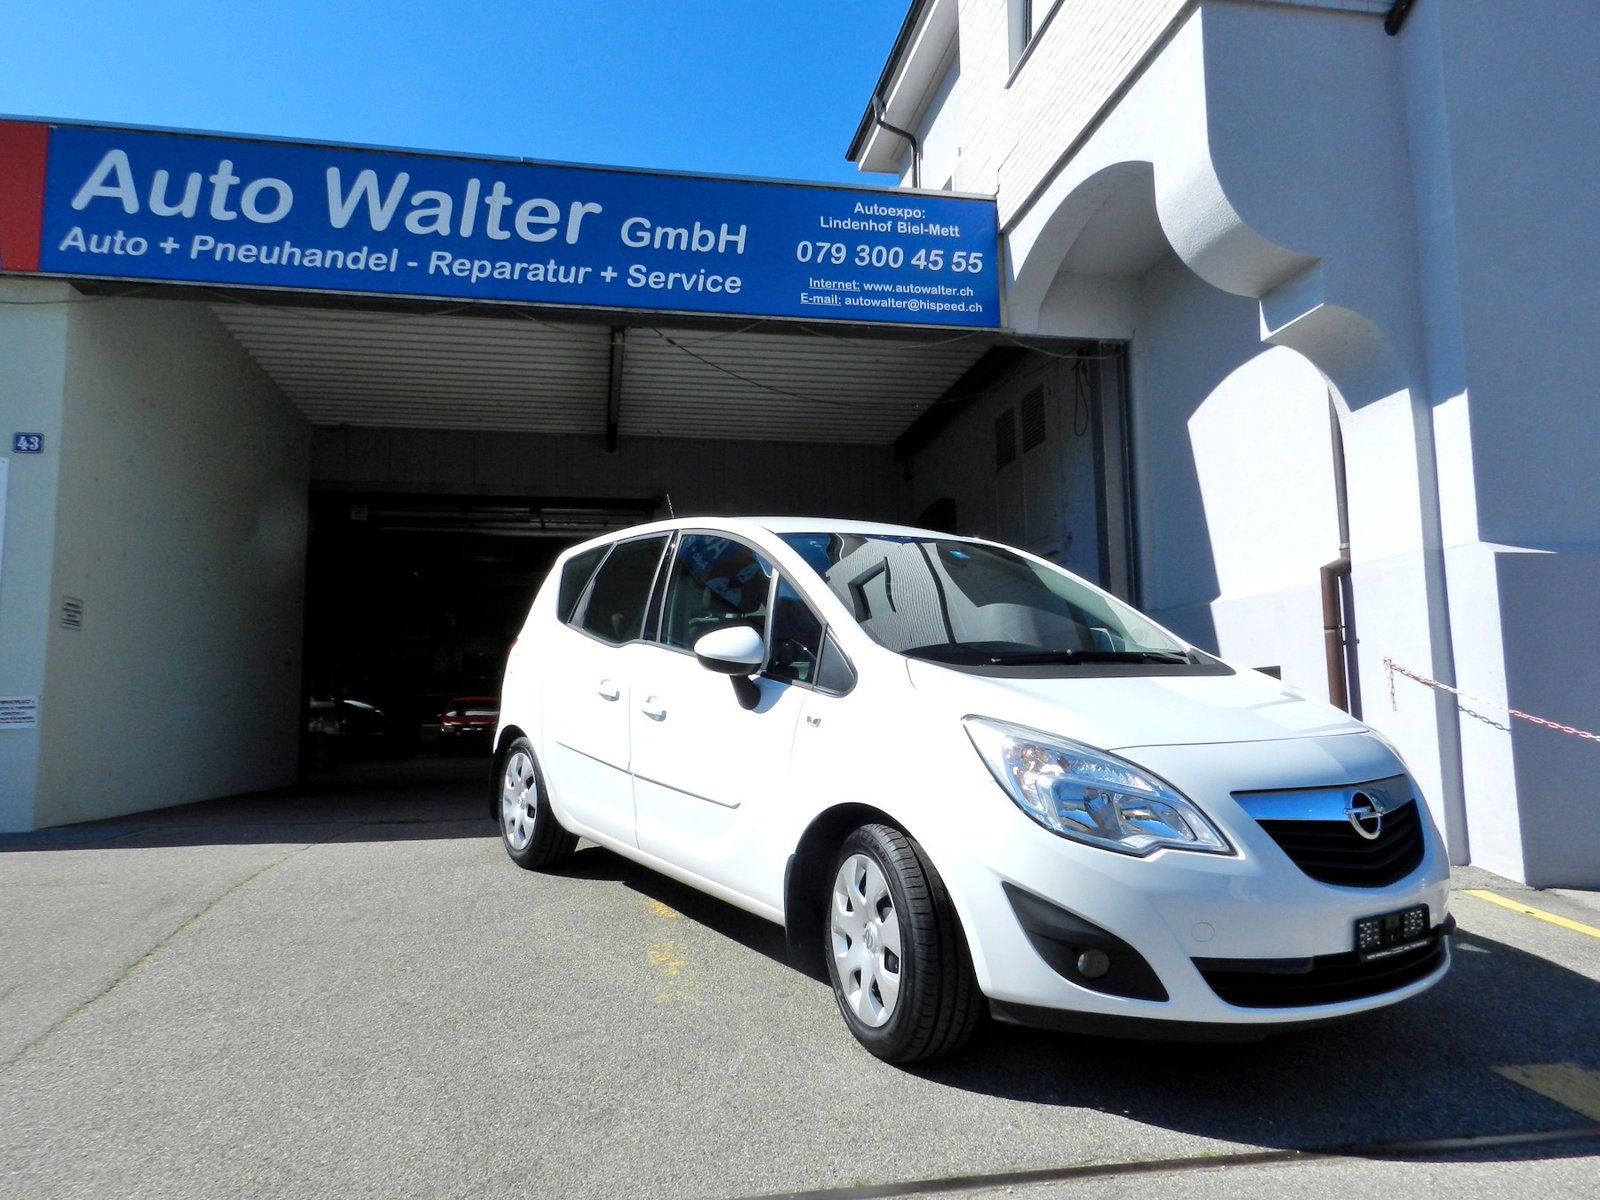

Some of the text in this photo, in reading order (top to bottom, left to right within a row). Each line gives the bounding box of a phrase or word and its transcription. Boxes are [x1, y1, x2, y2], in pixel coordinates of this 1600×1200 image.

[71, 149, 747, 255] Auto Walter GmbH
[854, 202, 926, 219] Autoexpo:
[819, 215, 961, 238] Lindenhof Biel-Mett
[58, 226, 148, 256] Auto
[190, 235, 399, 273] Pneuhandel
[428, 251, 593, 284] Reparatur
[626, 264, 742, 294] Service
[796, 240, 983, 274] 079 300 45 55
[809, 277, 974, 297] Internet: www.autowalter.ch
[800, 292, 983, 313] E-mail: autowalter@hispeed.ch
[17, 436, 40, 451] 43
